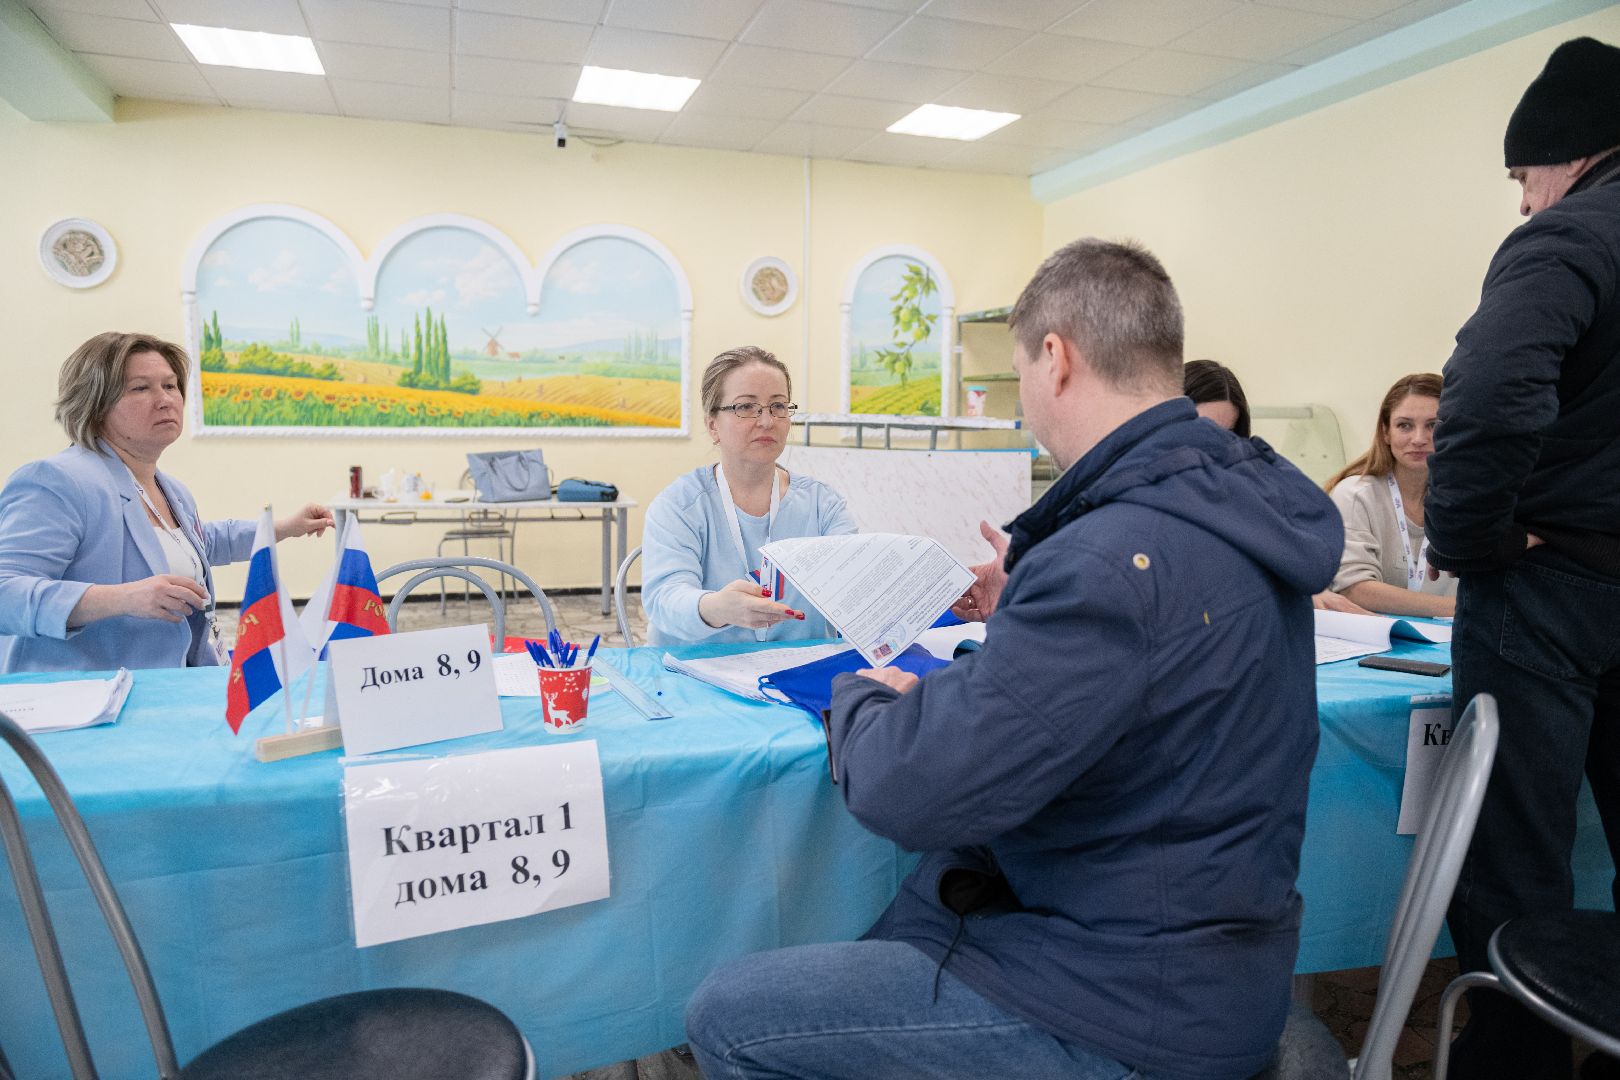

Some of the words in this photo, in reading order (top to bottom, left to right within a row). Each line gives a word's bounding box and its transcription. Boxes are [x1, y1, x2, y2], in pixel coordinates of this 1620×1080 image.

[360, 663, 424, 693] Дома
[437, 653, 461, 680] 8,
[467, 649, 481, 673] 9
[382, 812, 545, 857] Квартал
[558, 802, 576, 831] 1
[394, 869, 488, 910] дома
[510, 855, 541, 887] 8,
[552, 849, 571, 879] 9
